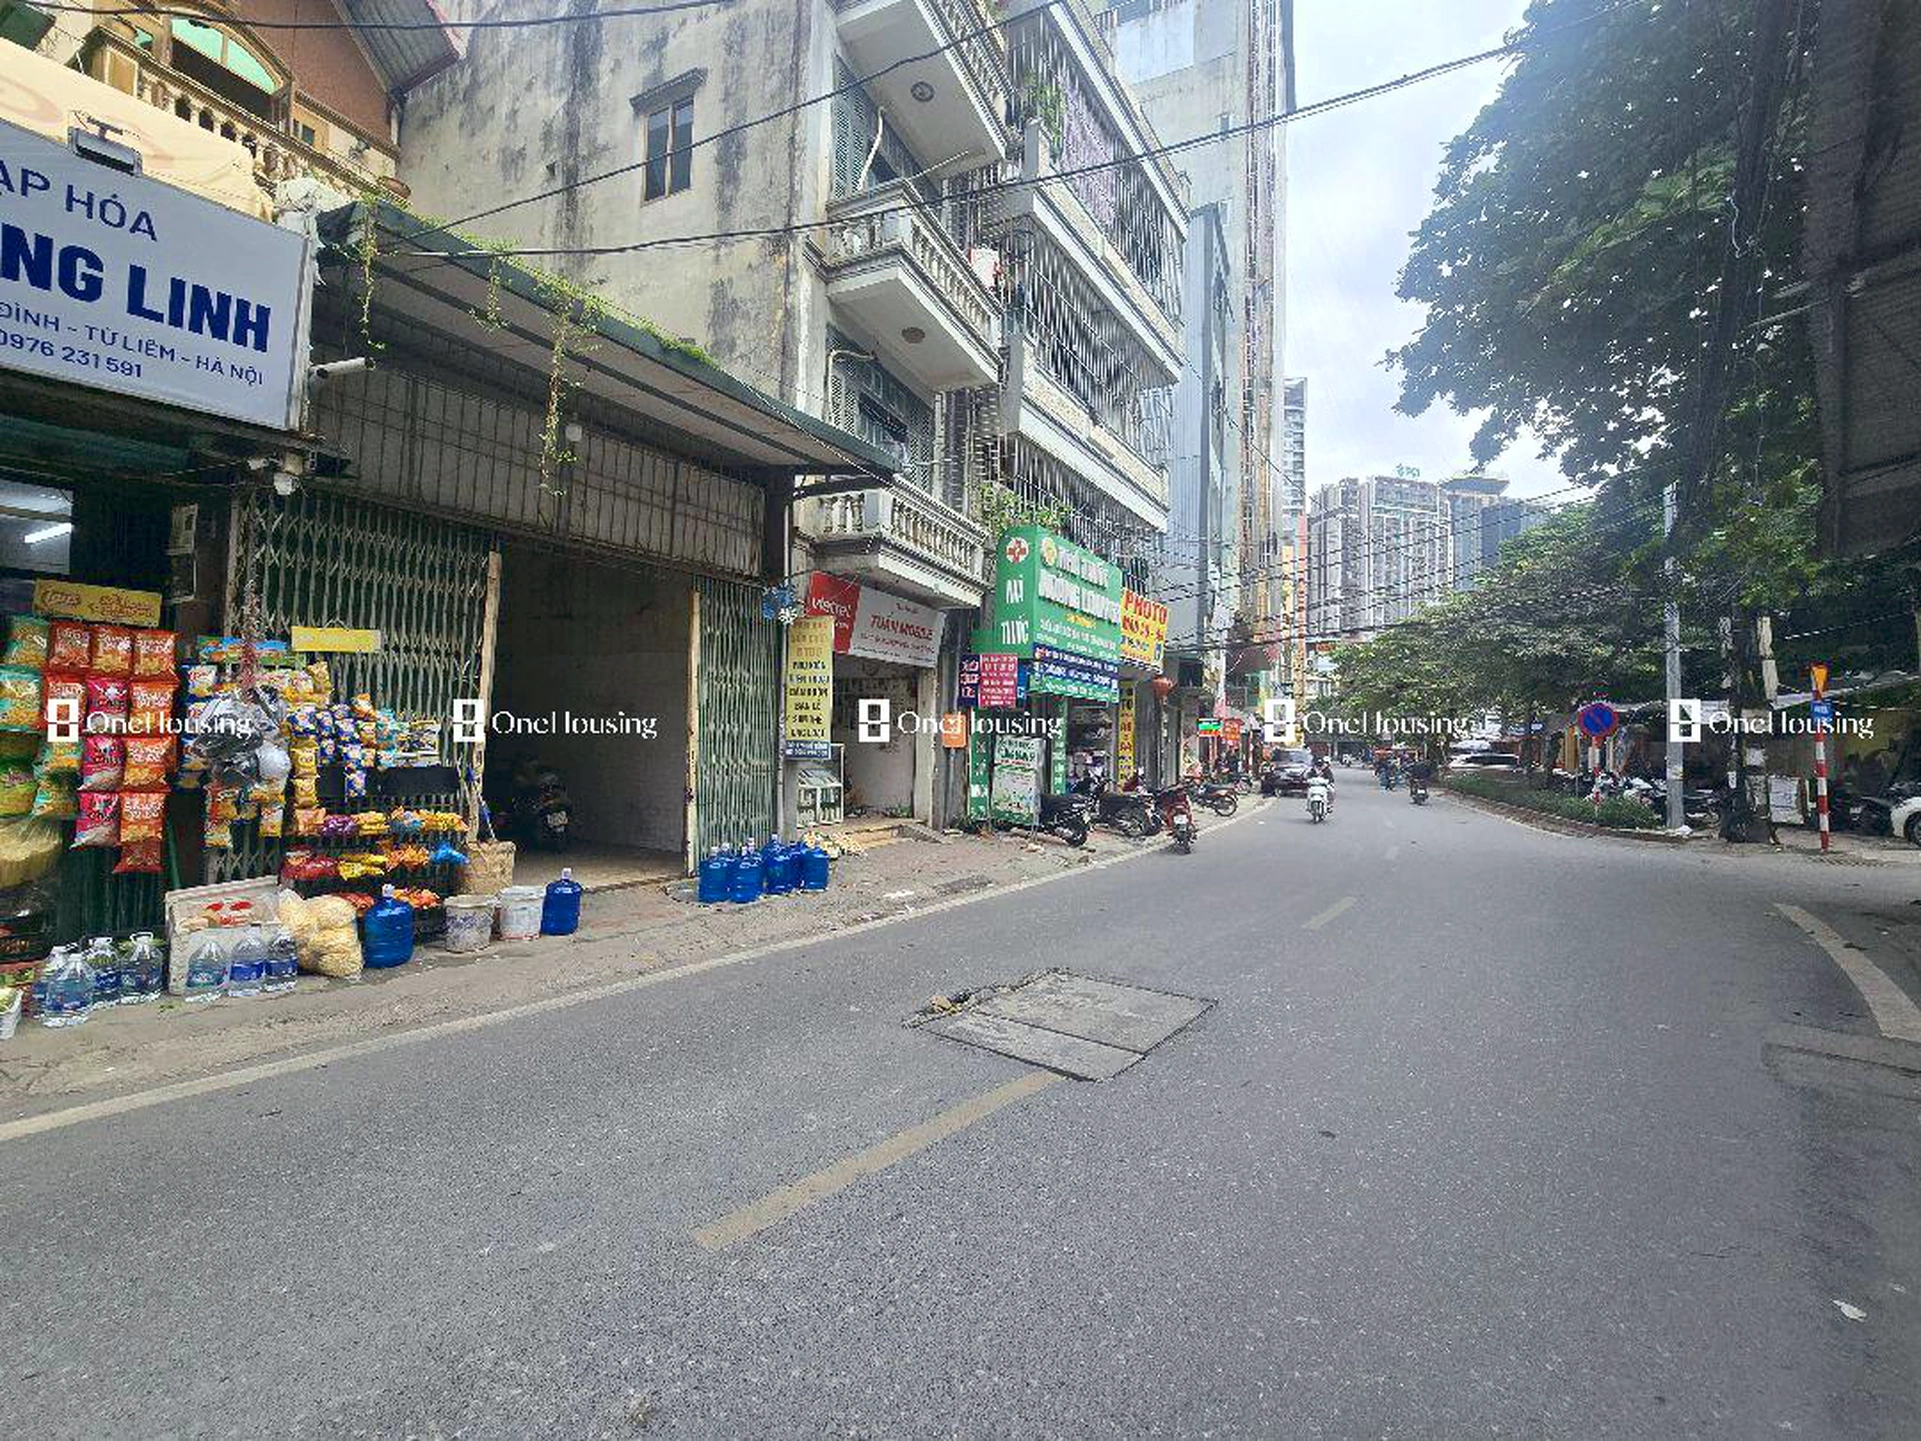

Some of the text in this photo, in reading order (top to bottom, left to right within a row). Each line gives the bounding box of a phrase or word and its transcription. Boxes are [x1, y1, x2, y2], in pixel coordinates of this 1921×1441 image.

[66, 184, 158, 242] HÓA
[126, 264, 271, 353] LINH
[61, 346, 100, 369] 231
[105, 356, 143, 378] 591
[196, 354, 225, 376] HÀ
[229, 363, 264, 388] NỘI
[1124, 589, 1169, 625] PHOTO
